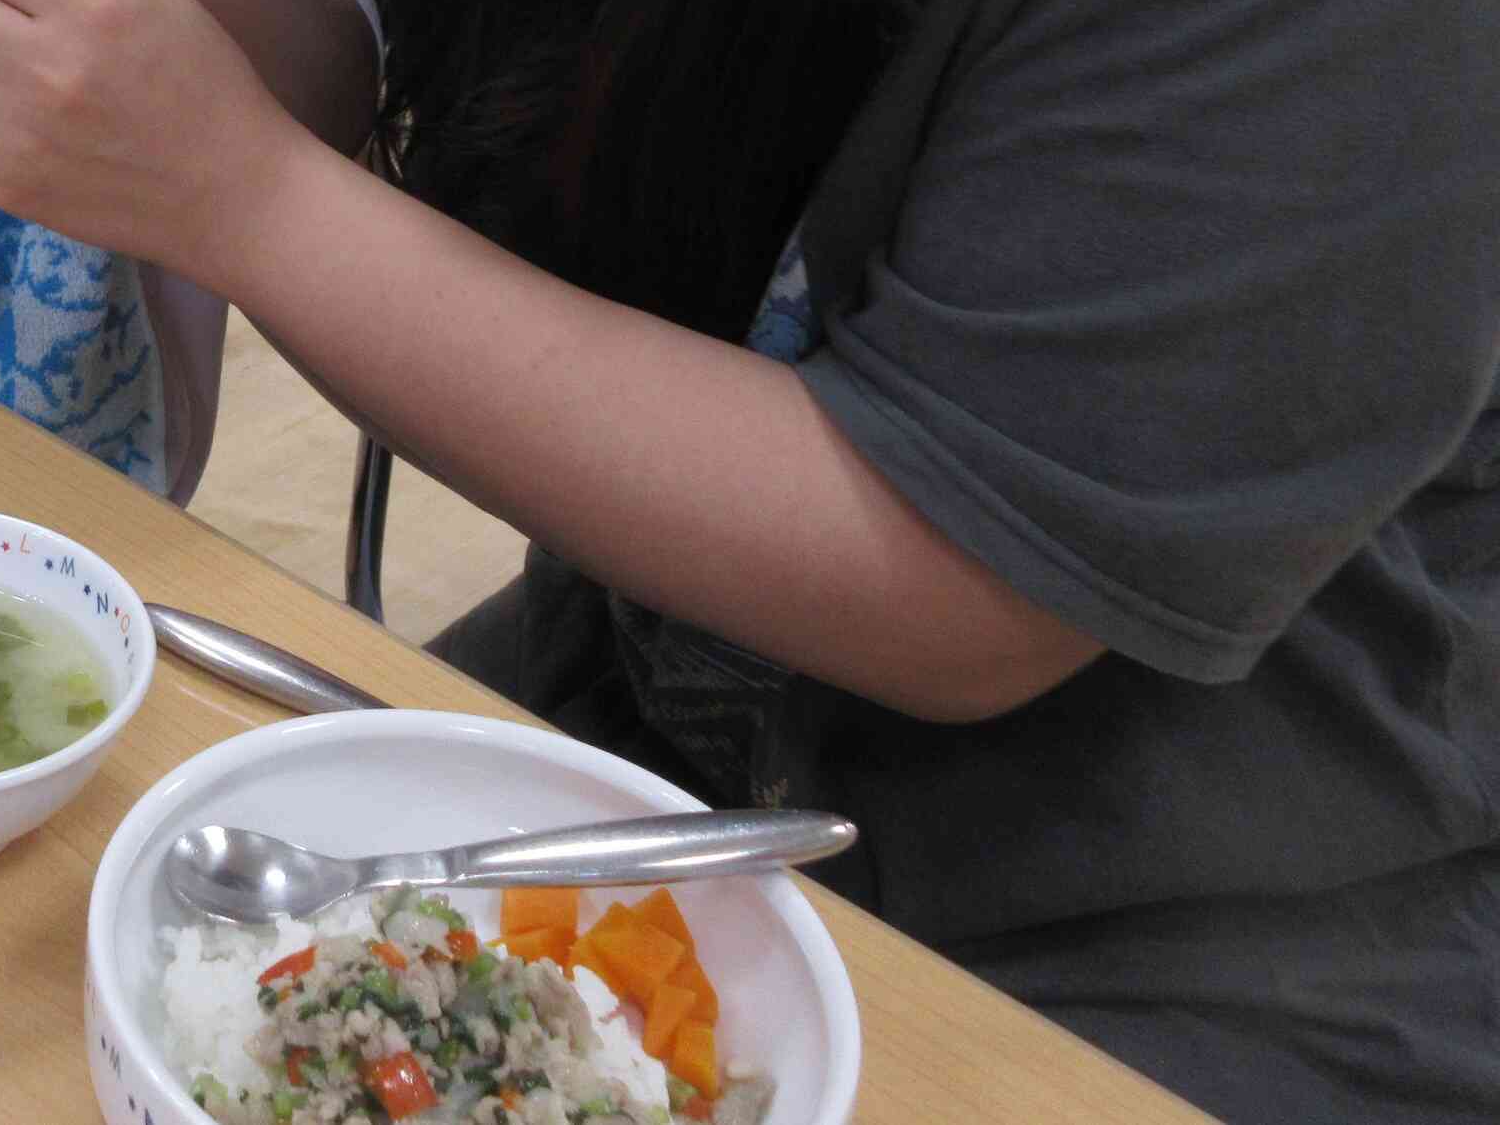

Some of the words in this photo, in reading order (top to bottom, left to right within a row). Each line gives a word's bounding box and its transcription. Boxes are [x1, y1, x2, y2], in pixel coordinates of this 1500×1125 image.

[20, 533, 32, 553] L
[60, 556, 75, 577] M
[97, 593, 108, 613] N
